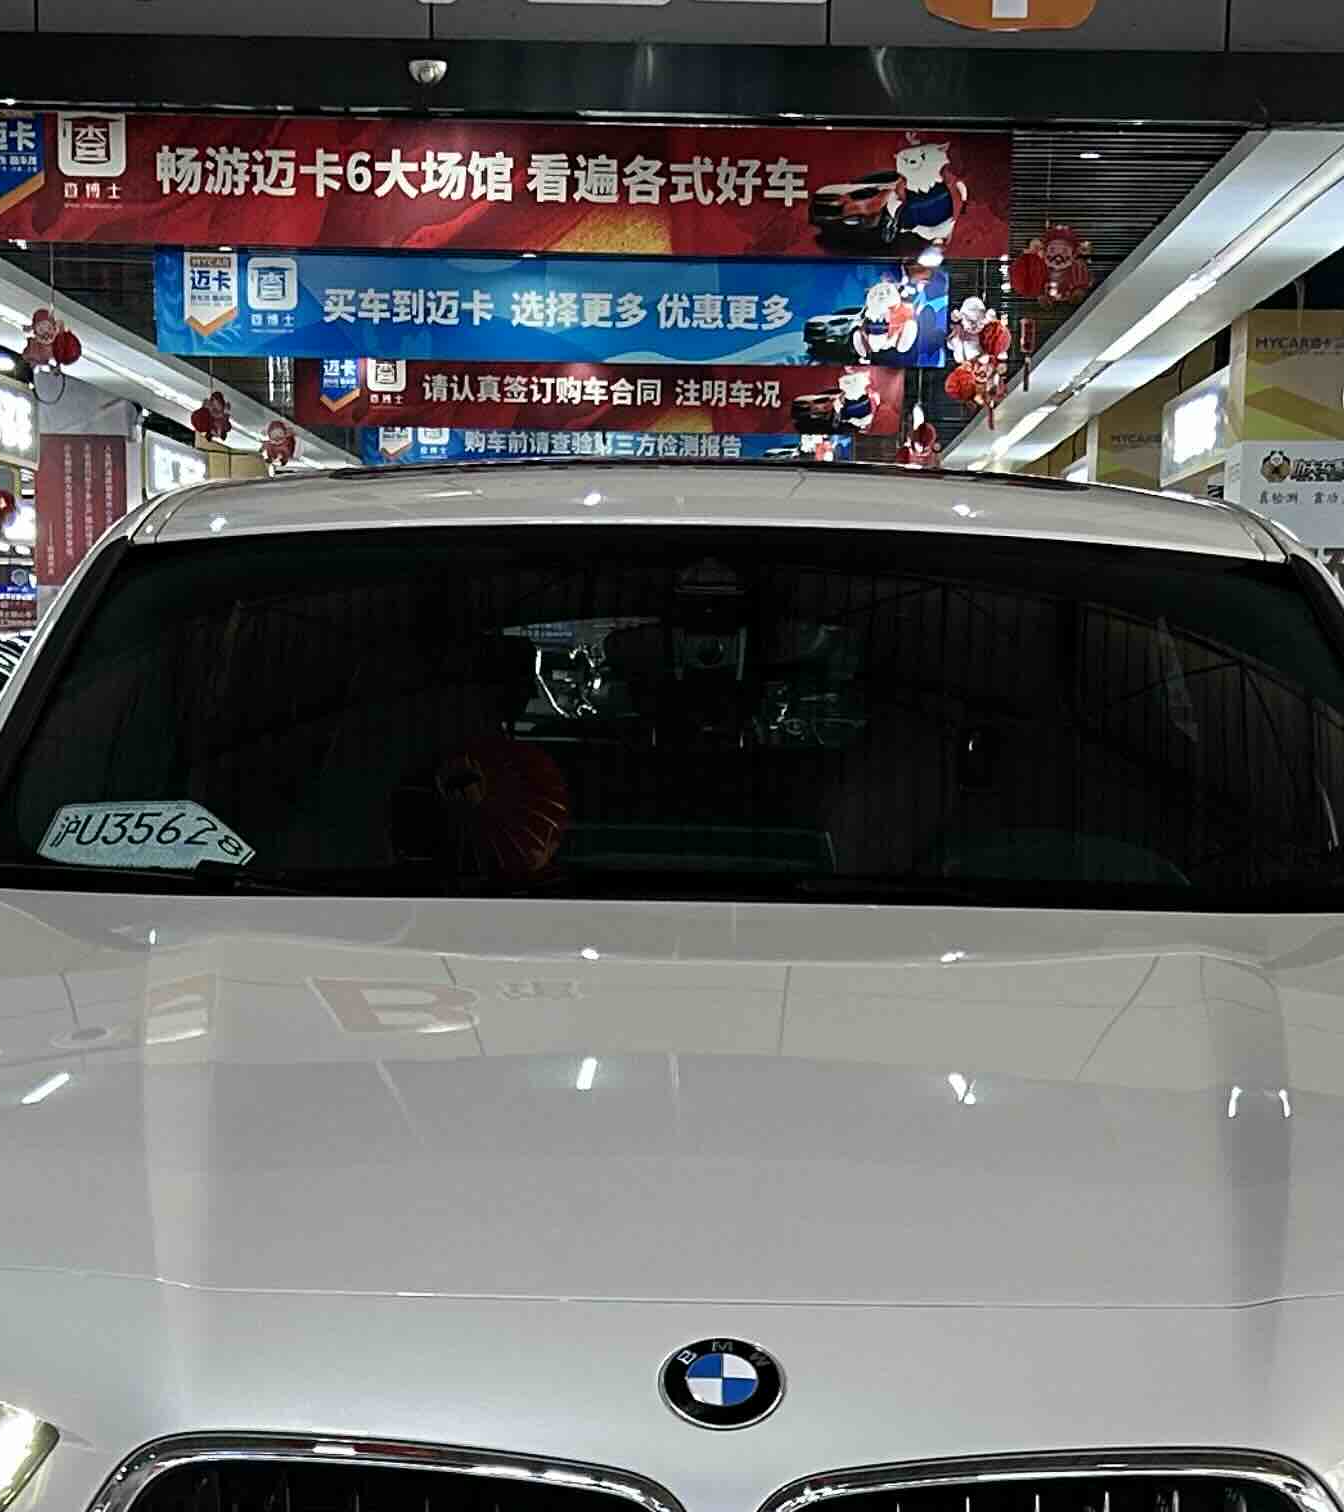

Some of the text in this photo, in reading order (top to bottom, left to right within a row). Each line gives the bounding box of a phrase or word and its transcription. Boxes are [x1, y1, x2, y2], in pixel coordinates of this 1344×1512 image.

[155, 144, 809, 207] 畅游迈卡6大场馆 看遍各式好车
[190, 270, 231, 291] 迈卡
[323, 287, 794, 332] 买车到迈卡 选择更多 优惠更多
[422, 373, 782, 409] 请认真签订购车合同 注明车况
[463, 429, 743, 459] 购车前请查验第三方检测报告
[49, 811, 244, 858] 沪U35628
